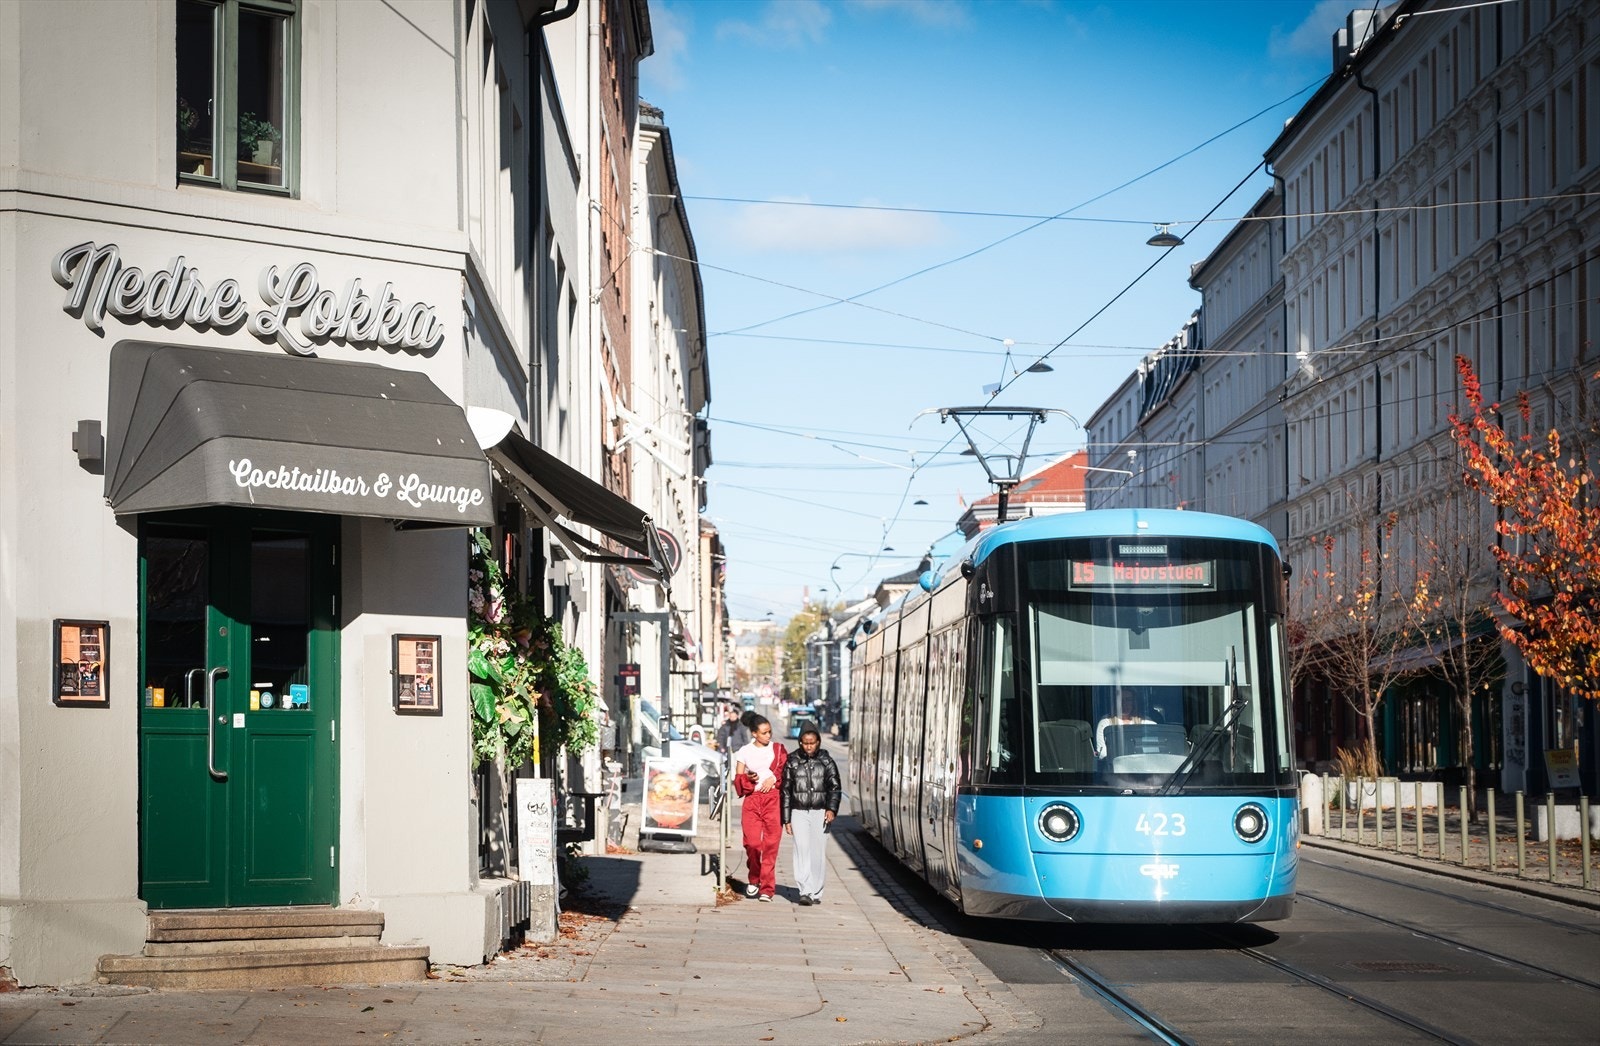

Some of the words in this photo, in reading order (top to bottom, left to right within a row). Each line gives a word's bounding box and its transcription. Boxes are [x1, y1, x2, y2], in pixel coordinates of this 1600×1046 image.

[52, 241, 247, 332] Nedre
[229, 458, 370, 496] Cocktailbar
[373, 473, 393, 497] &
[396, 473, 484, 513] Lounge
[1073, 562, 1095, 583] 15
[1114, 562, 1204, 584] Majorstuen
[1135, 813, 1187, 836] 423
